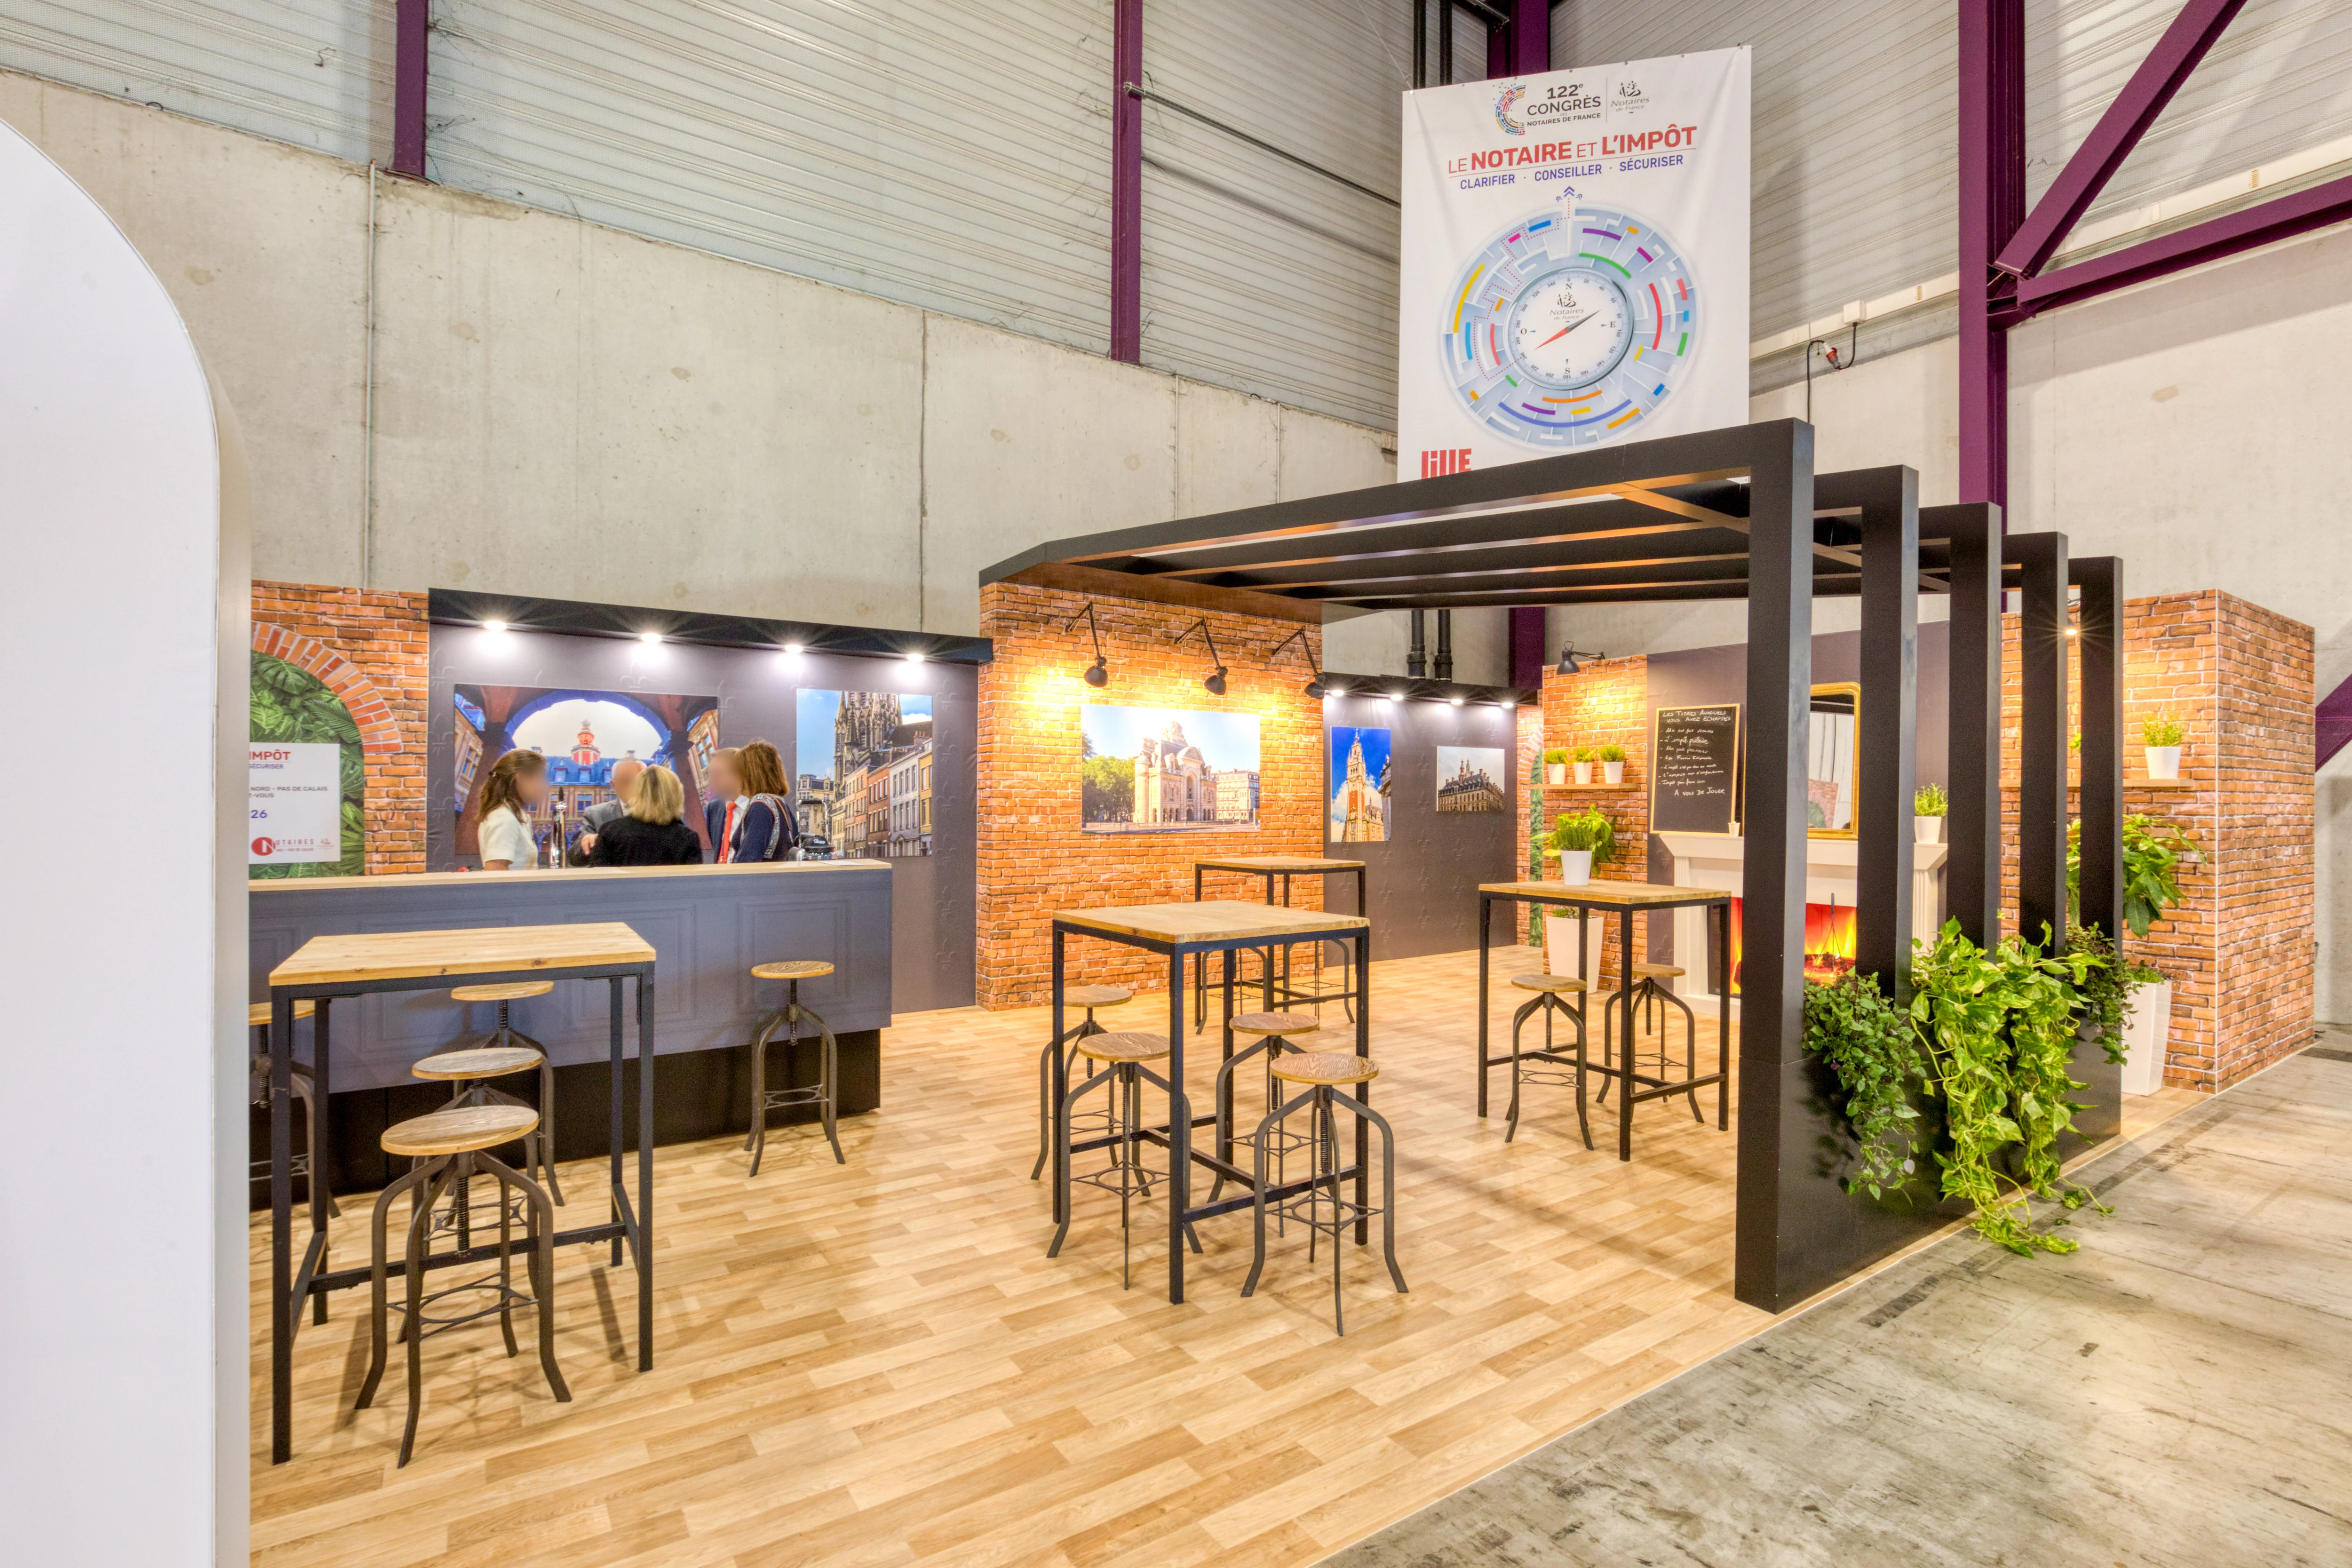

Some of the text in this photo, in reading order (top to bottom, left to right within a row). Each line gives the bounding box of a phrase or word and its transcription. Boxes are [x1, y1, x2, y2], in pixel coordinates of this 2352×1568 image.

[1527, 95, 1601, 116] CONGRÈS
[1611, 97, 1650, 108] Notaires
[1527, 117, 1560, 127] NOTAIRES
[1573, 112, 1601, 121] FRANCE
[1448, 123, 1697, 174] LE NOTAIRE ET L'IMPÔT
[1460, 154, 1683, 190] CLARIFIER CONSEILLER SÉCURISER
[1549, 308, 1584, 316] Notaires
